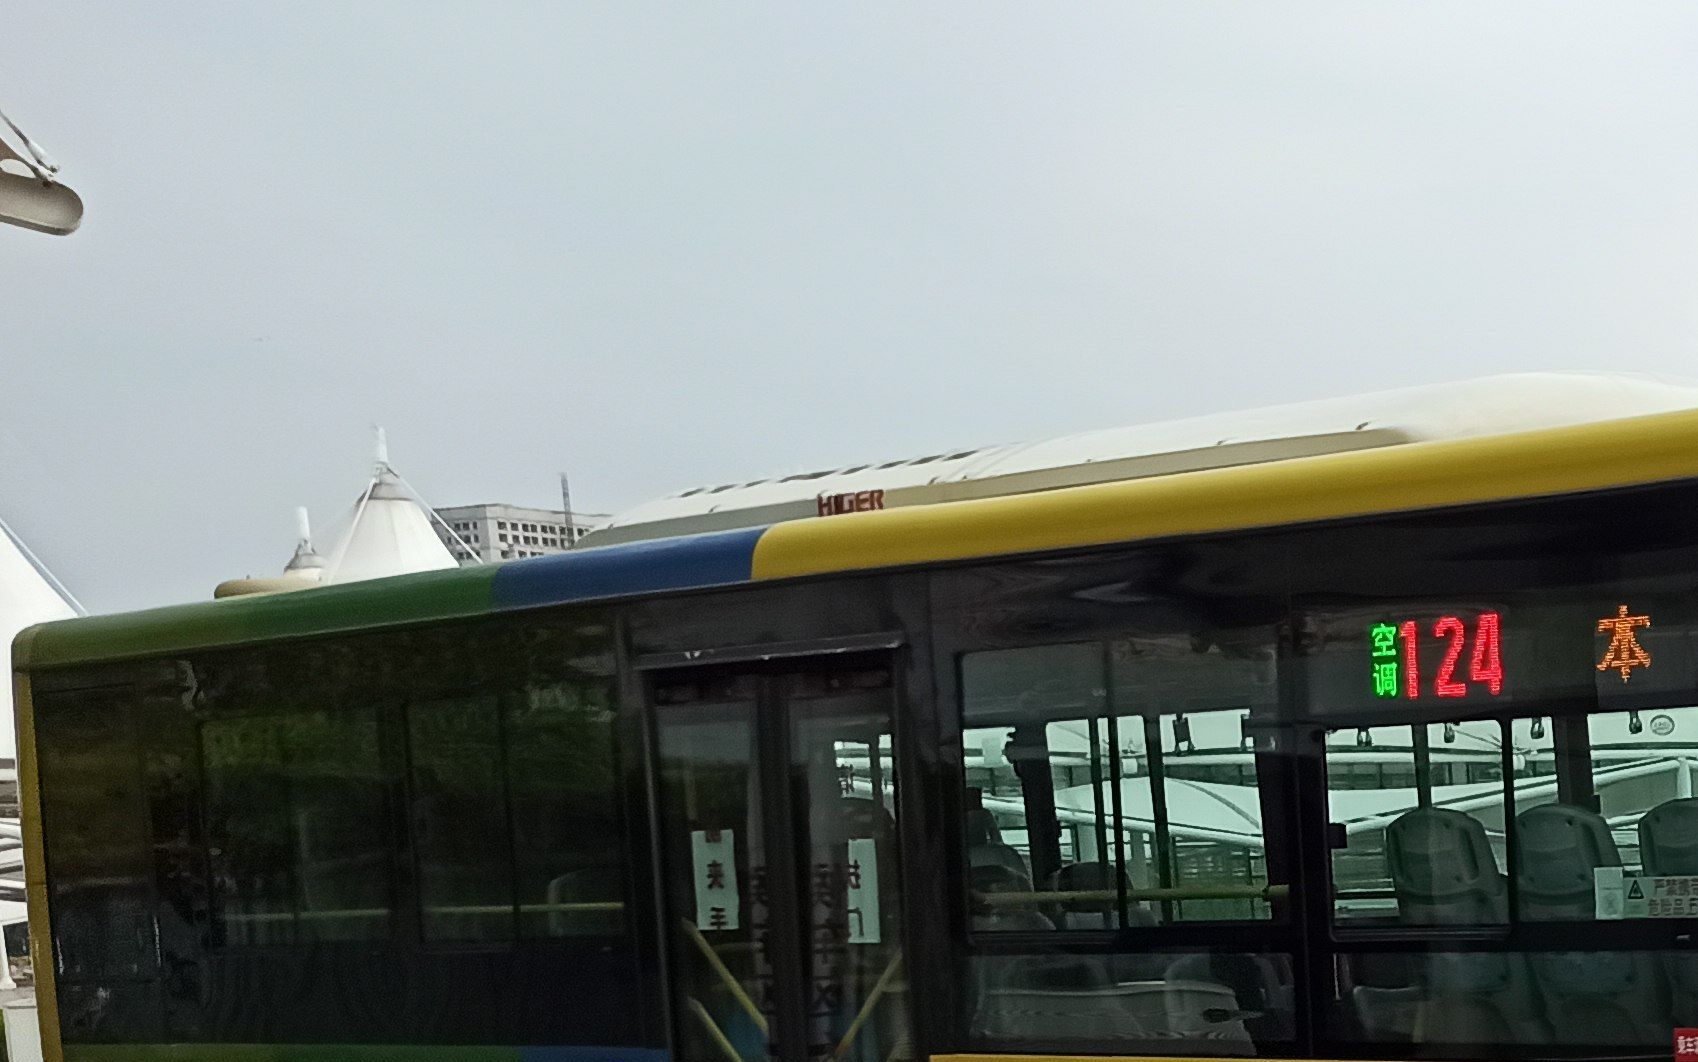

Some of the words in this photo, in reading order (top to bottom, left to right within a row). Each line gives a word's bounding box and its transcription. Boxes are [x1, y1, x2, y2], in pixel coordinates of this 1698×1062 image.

[816, 489, 885, 517] HIGER
[1371, 622, 1398, 698] 空调
[1400, 612, 1502, 699] 124
